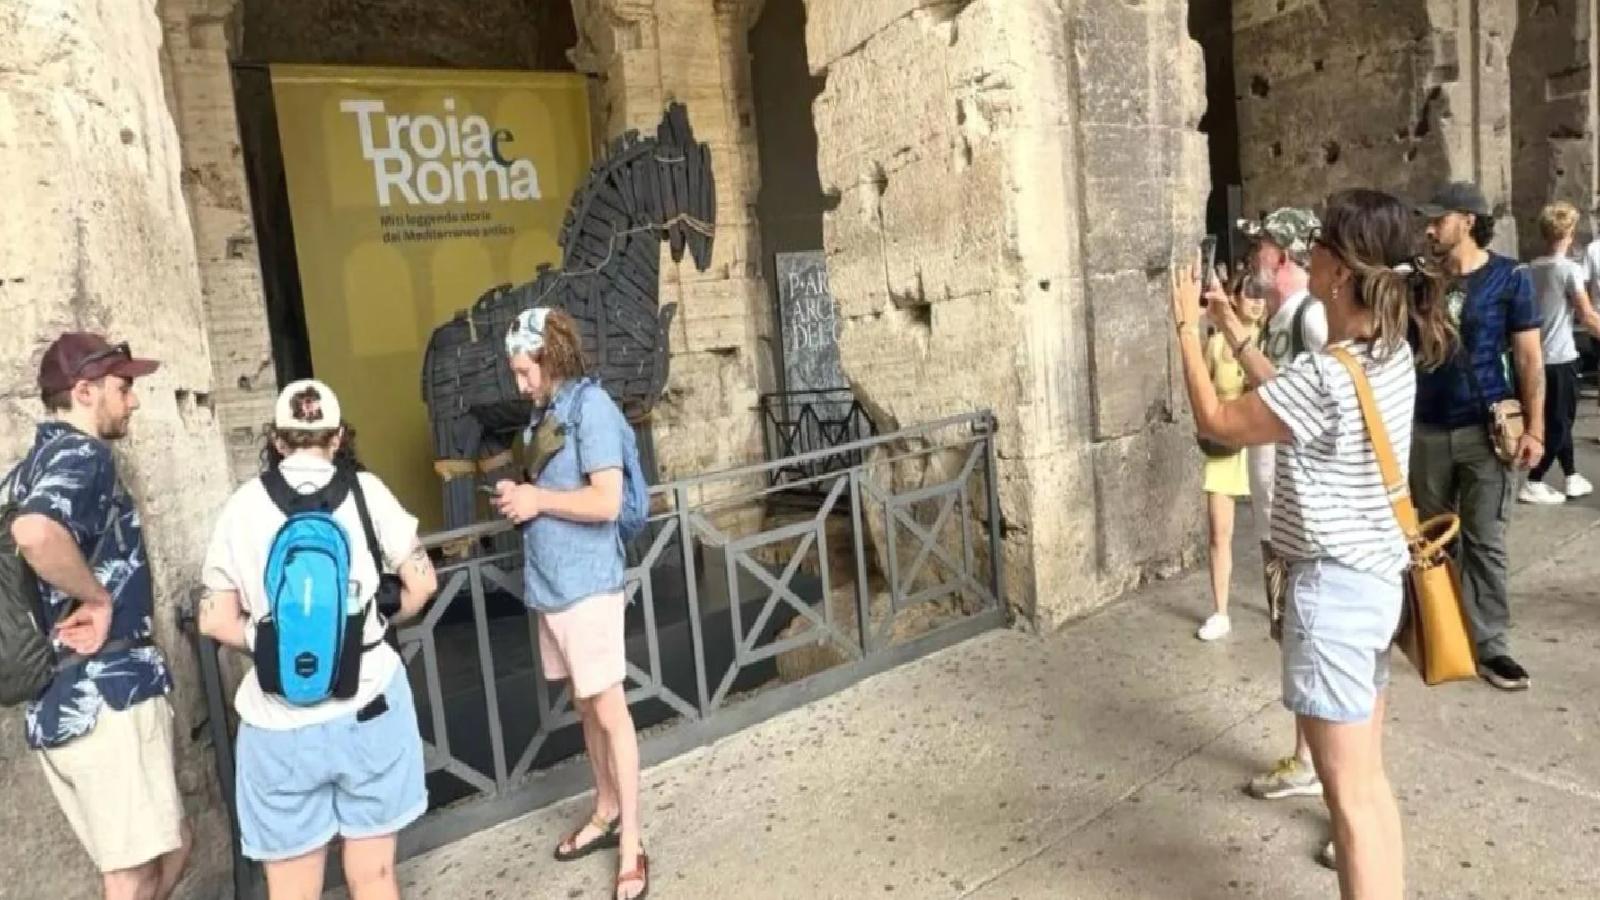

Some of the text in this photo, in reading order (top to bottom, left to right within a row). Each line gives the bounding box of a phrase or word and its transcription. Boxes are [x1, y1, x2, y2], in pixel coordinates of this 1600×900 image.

[339, 98, 516, 167] Troia e
[373, 150, 542, 206] Roma
[403, 227, 480, 242] Mediterraneo
[405, 212, 458, 228] leggende
